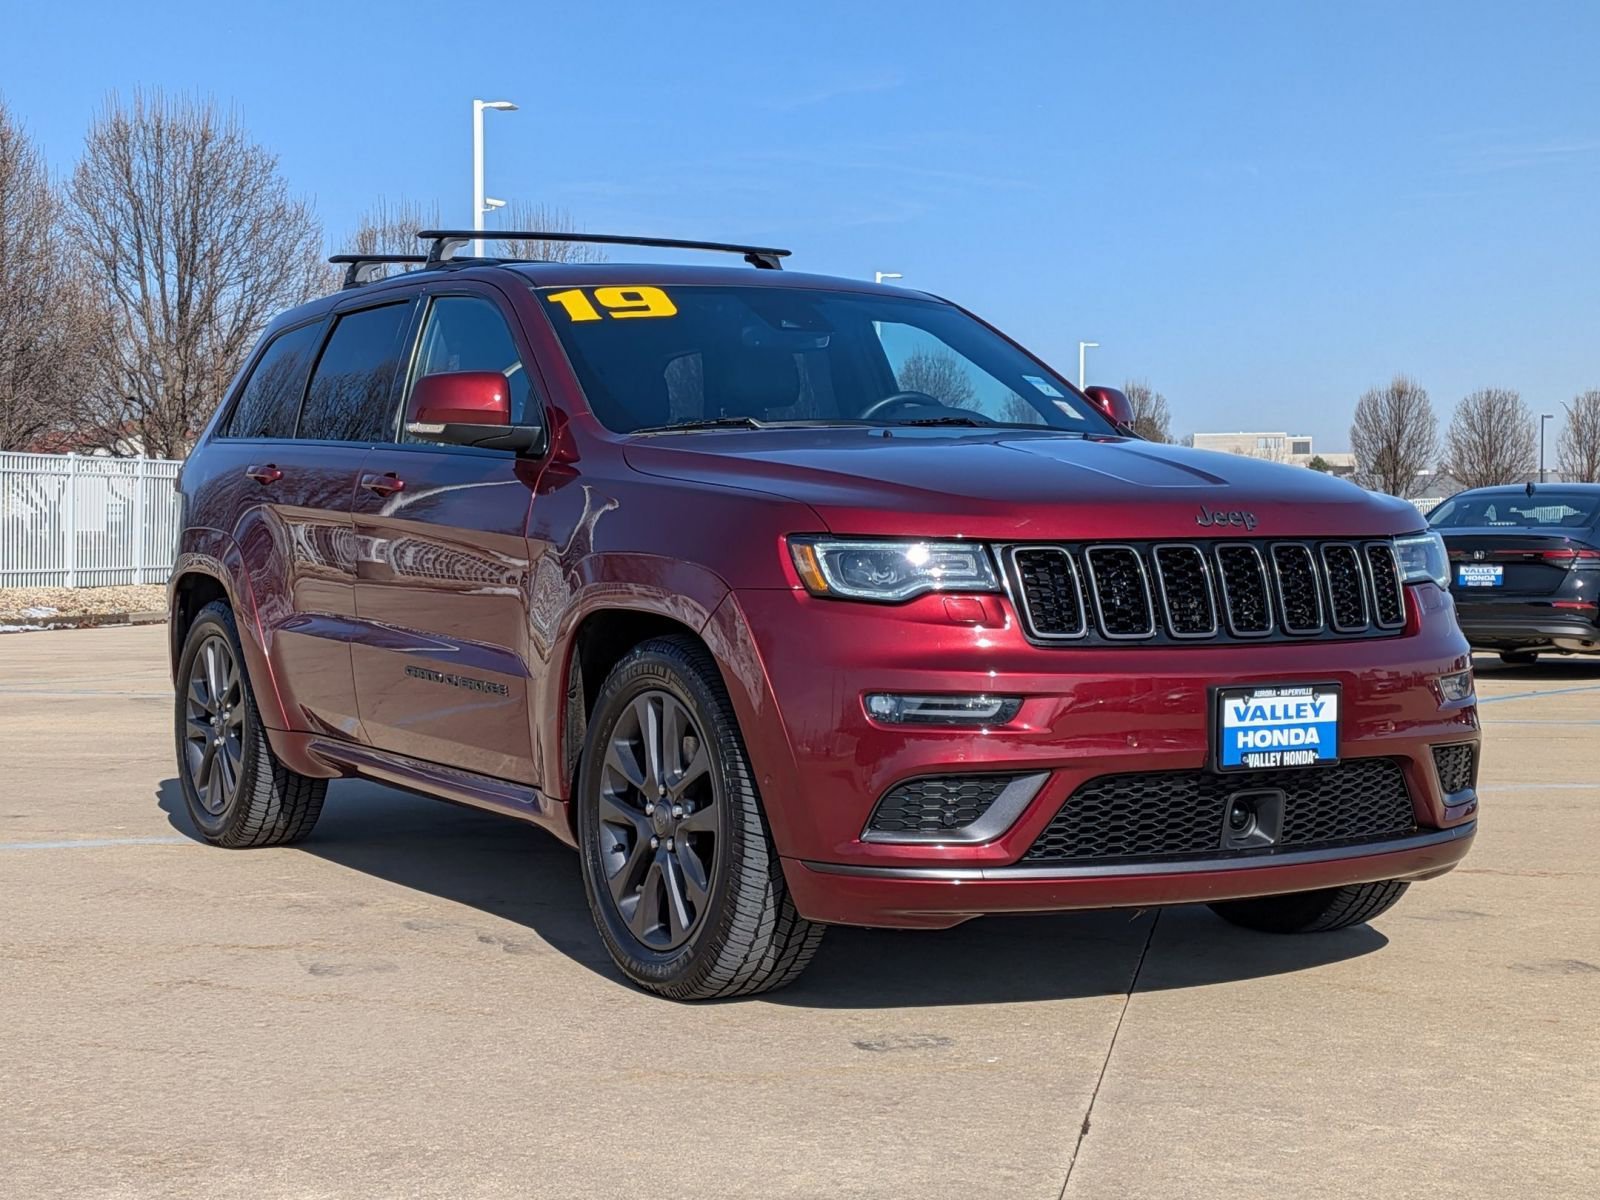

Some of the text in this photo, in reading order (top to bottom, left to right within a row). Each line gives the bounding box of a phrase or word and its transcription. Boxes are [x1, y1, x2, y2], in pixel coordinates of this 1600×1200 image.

[547, 286, 678, 322] 19
[1195, 504, 1258, 531] Jeep
[1233, 702, 1325, 722] VALLEY
[1237, 727, 1320, 749] HONDA
[1248, 750, 1314, 768] VALLEY HONDA
